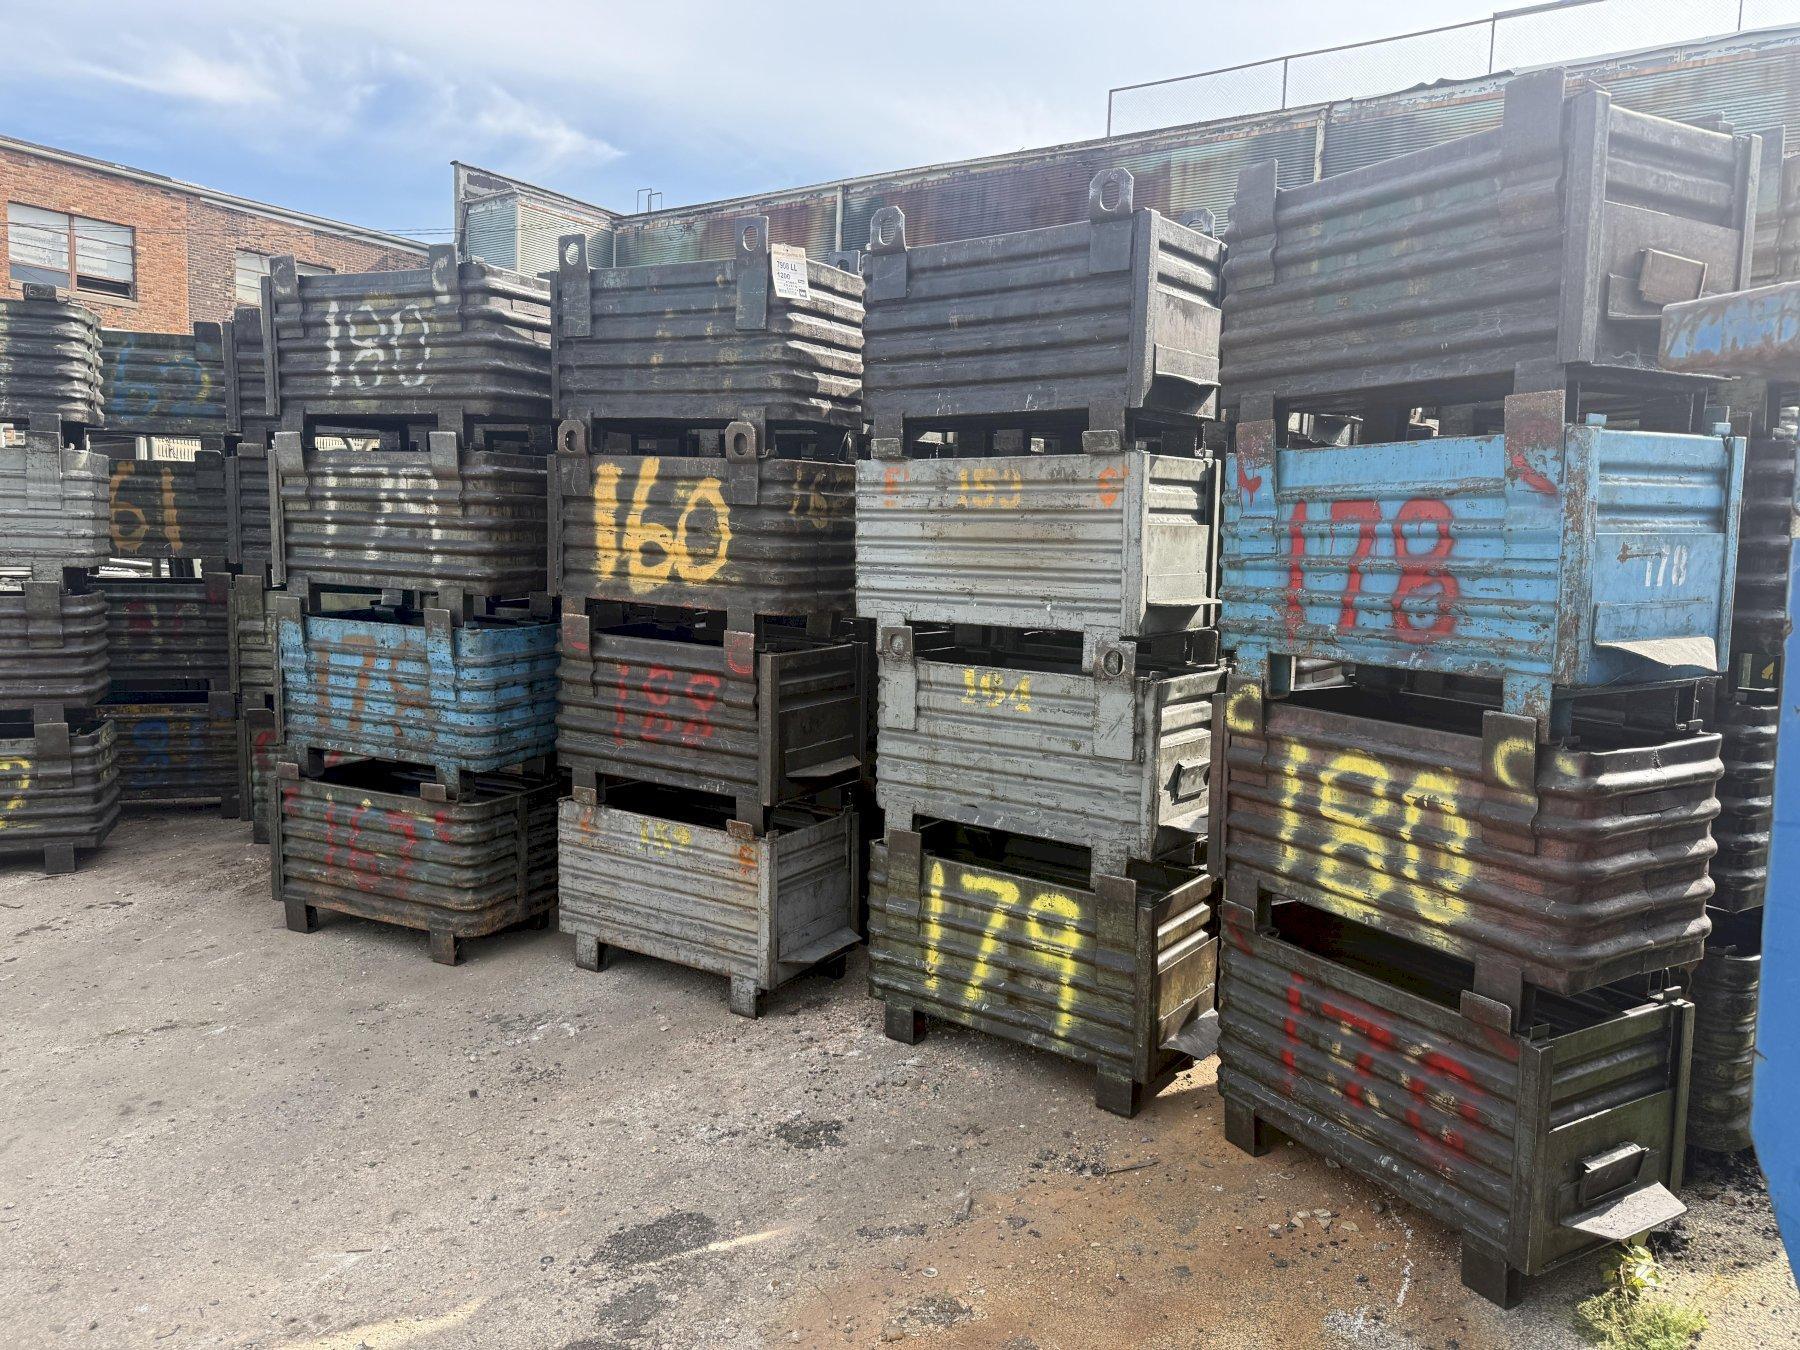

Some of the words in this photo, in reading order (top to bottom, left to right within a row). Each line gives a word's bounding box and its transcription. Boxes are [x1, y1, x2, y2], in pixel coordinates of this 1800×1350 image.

[325, 300, 431, 393] 180
[594, 457, 731, 594] 160
[1287, 497, 1461, 645] 178
[1645, 544, 1688, 587] 178
[1226, 684, 1262, 732] C
[1279, 740, 1473, 942] 180
[924, 862, 1081, 1045] 179
